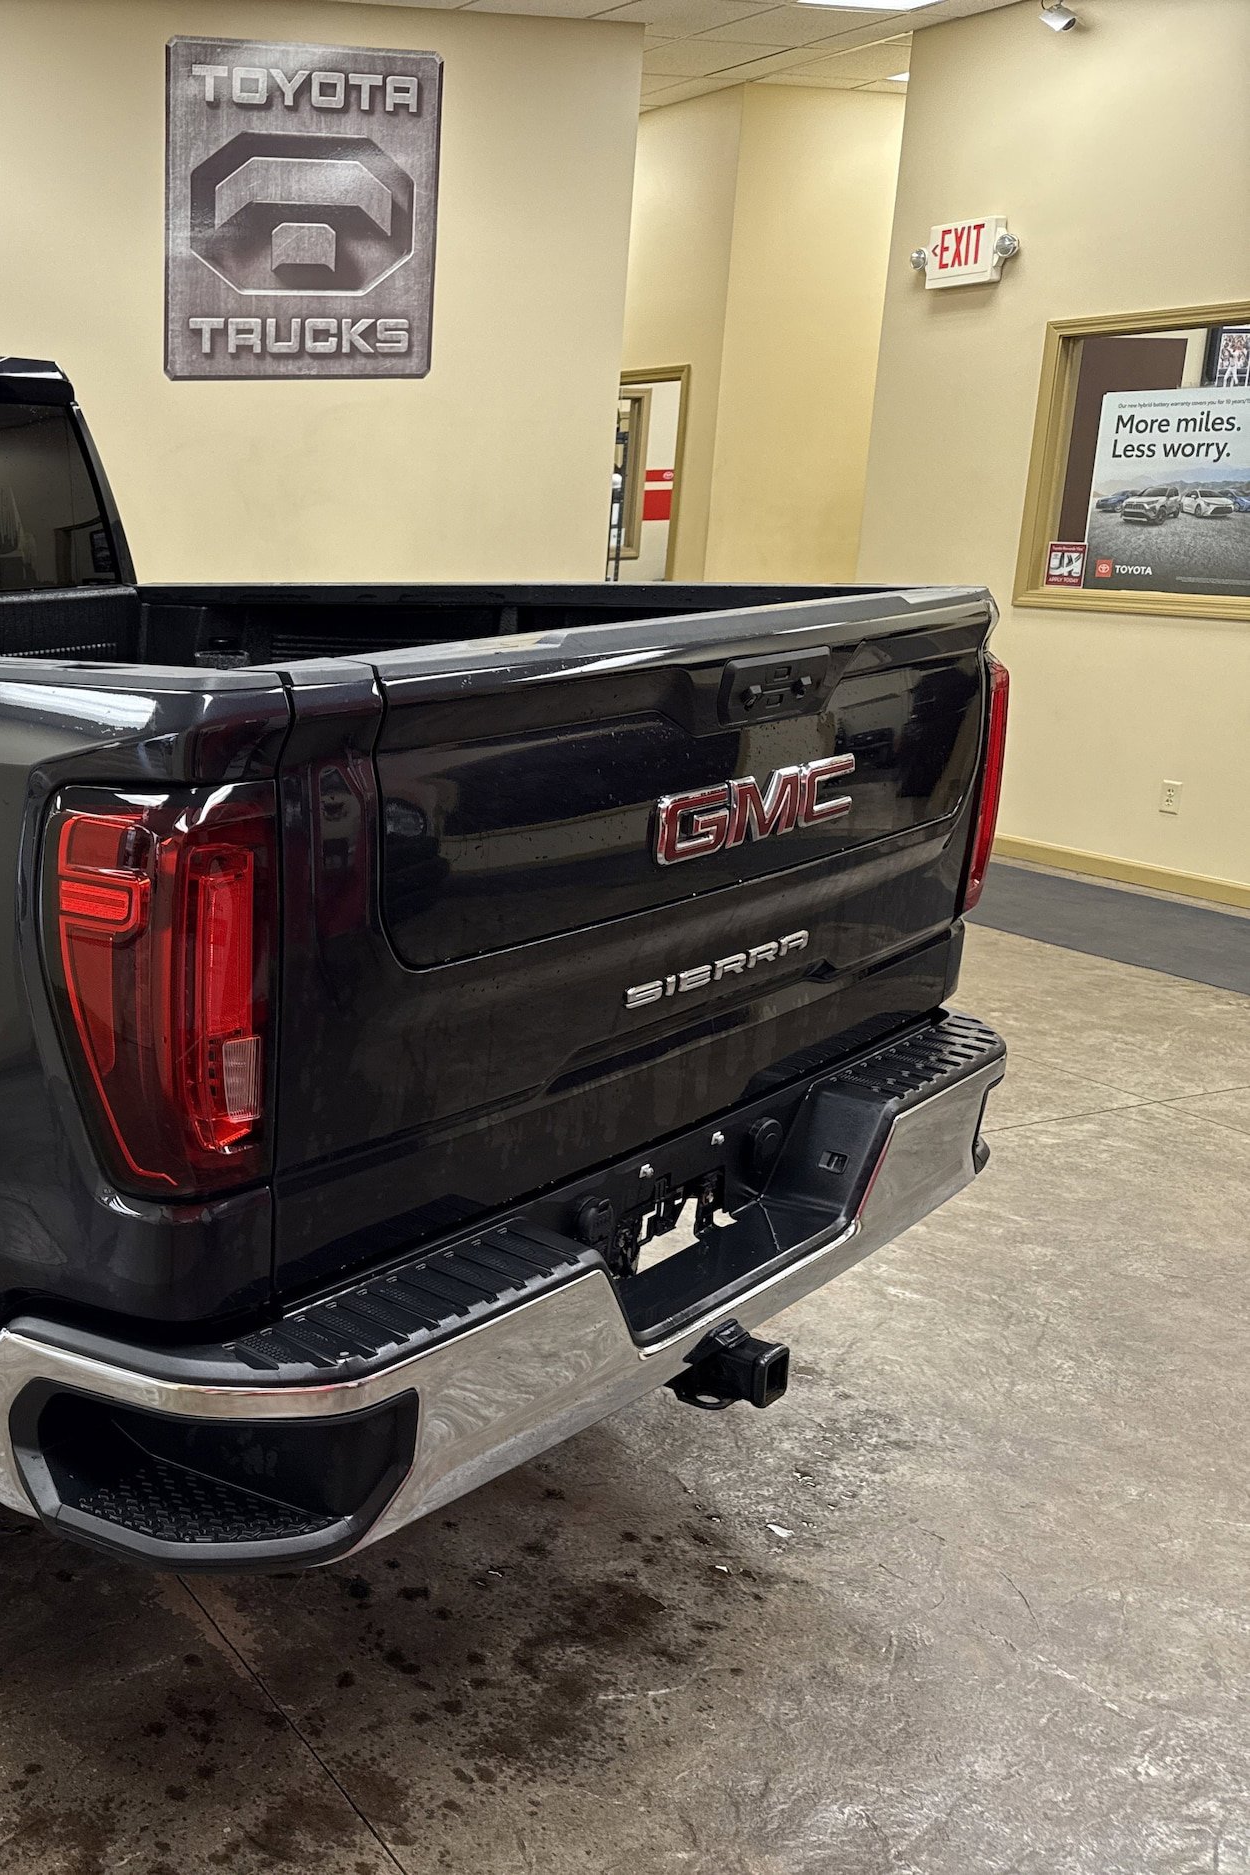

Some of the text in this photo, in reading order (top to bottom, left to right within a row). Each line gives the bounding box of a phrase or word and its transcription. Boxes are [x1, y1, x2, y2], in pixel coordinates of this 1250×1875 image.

[191, 64, 418, 113] TOYOTA
[939, 223, 985, 269] EXIT
[188, 317, 409, 354] TRUCKS
[1115, 410, 1241, 434] More miles.
[1111, 439, 1231, 463] Less worry.
[1115, 565, 1153, 575] TOYOTA
[656, 753, 856, 865] GMC
[625, 930, 810, 1009] SIERRA
